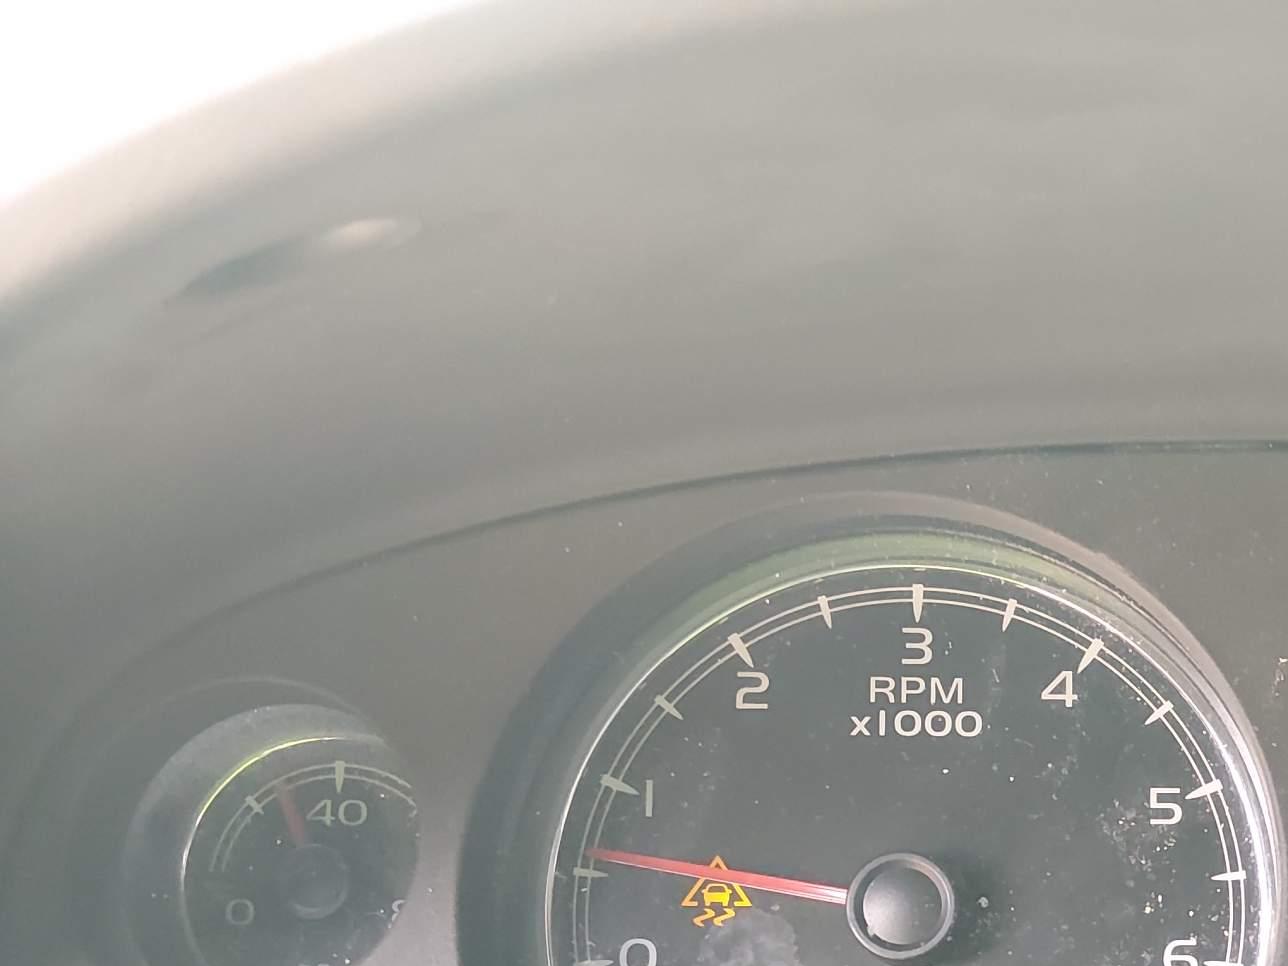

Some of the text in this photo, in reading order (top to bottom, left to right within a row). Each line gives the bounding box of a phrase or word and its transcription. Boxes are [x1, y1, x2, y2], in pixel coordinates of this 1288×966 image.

[902, 628, 933, 665] 3
[735, 671, 769, 710] 2
[870, 676, 964, 704] RPM
[1041, 671, 1078, 707] 4
[850, 710, 983, 737] x1000
[306, 799, 368, 826] 40
[645, 780, 653, 817] 1
[1149, 787, 1182, 825] 5
[225, 899, 255, 925] 0
